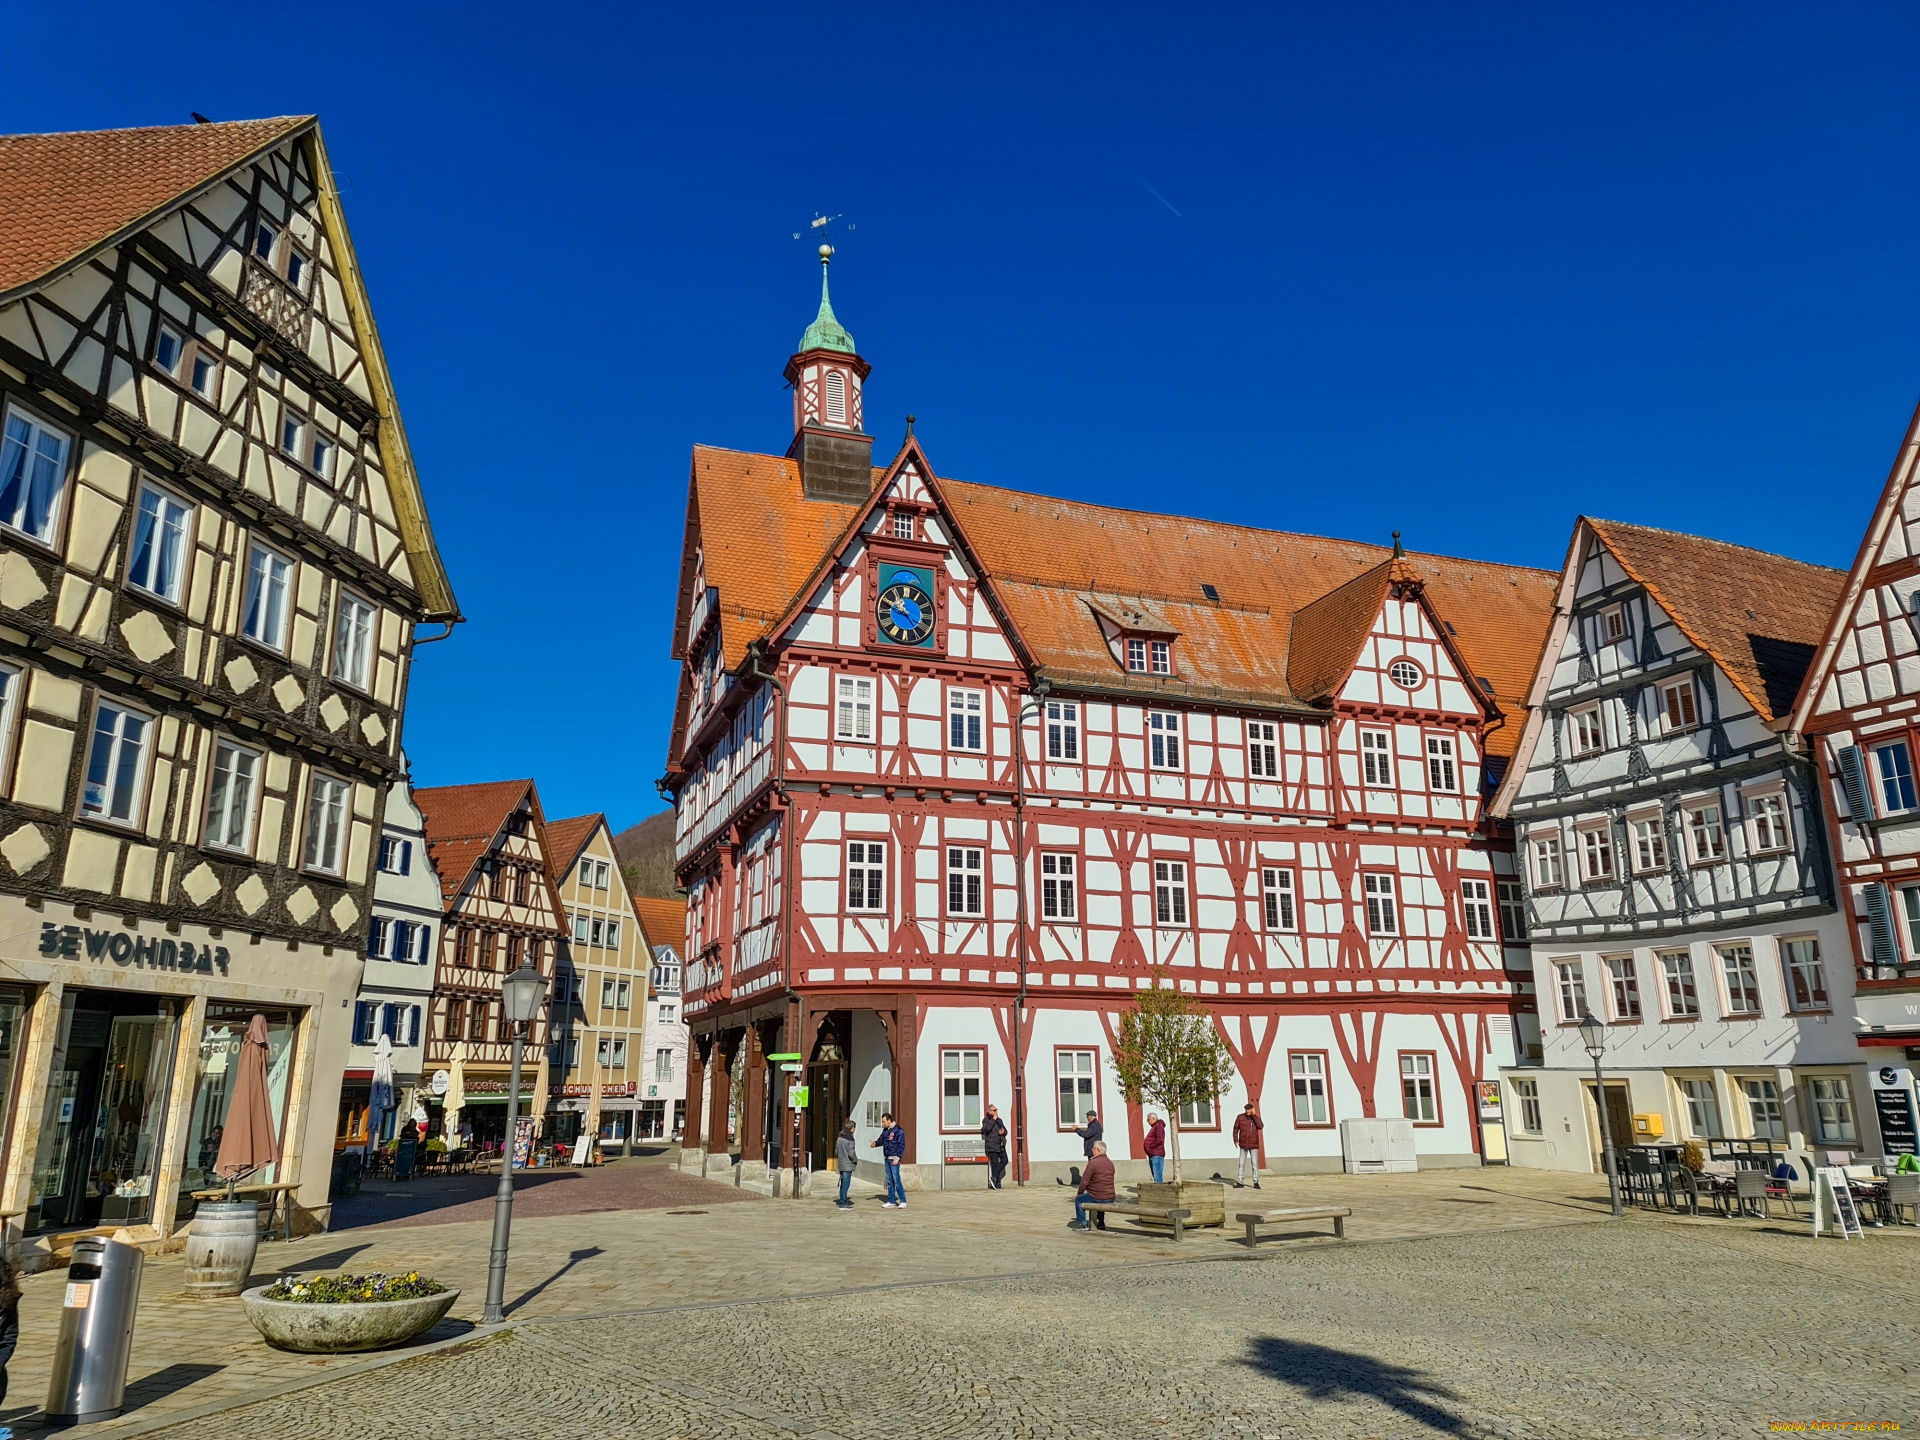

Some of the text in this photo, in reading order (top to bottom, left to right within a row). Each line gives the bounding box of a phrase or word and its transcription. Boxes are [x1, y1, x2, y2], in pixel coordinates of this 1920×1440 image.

[1905, 1004, 1918, 1016] W
[500, 1080, 536, 1090] capion
[562, 1085, 626, 1095] SCHUMCHER
